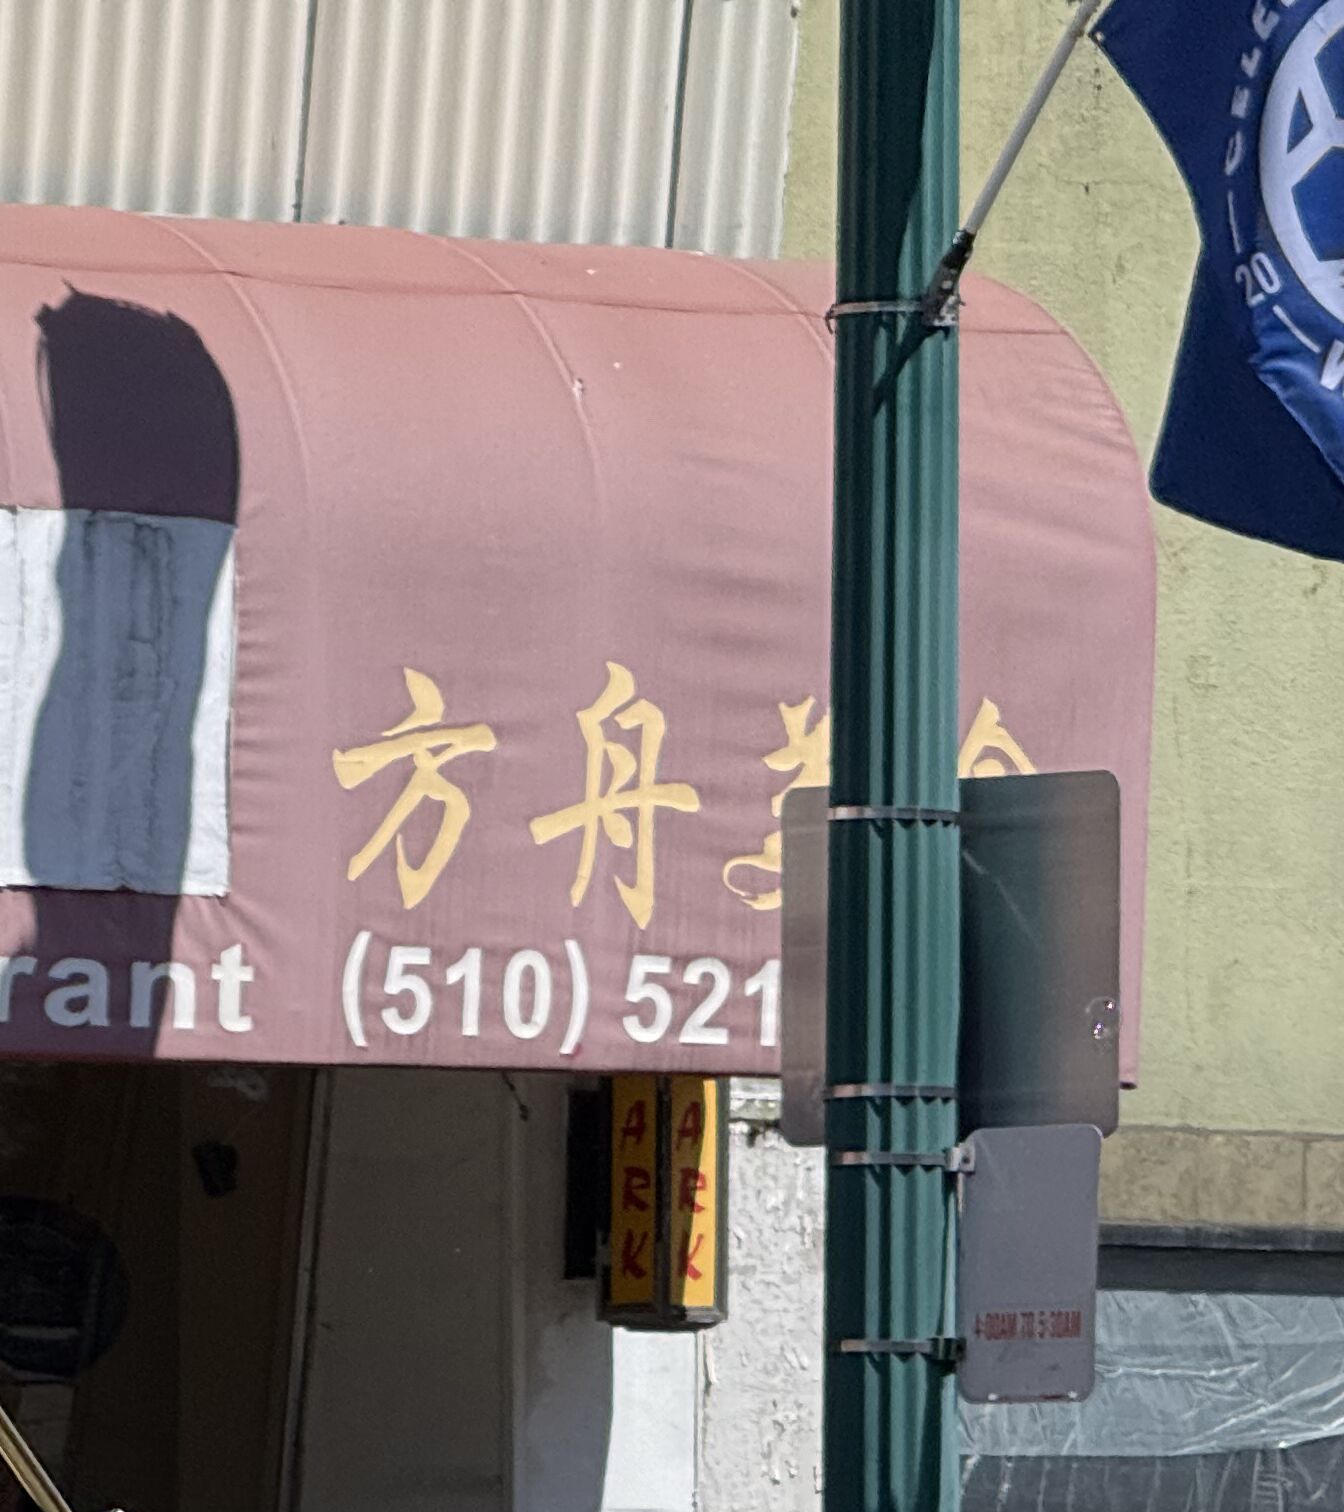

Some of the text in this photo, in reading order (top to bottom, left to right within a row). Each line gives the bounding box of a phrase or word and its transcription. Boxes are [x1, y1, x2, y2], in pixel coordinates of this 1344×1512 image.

[1234, 251, 1283, 307] 20
[342, 930, 591, 1056] (510)
[620, 1099, 651, 1281] ARK
[676, 1101, 708, 1282] ARK
